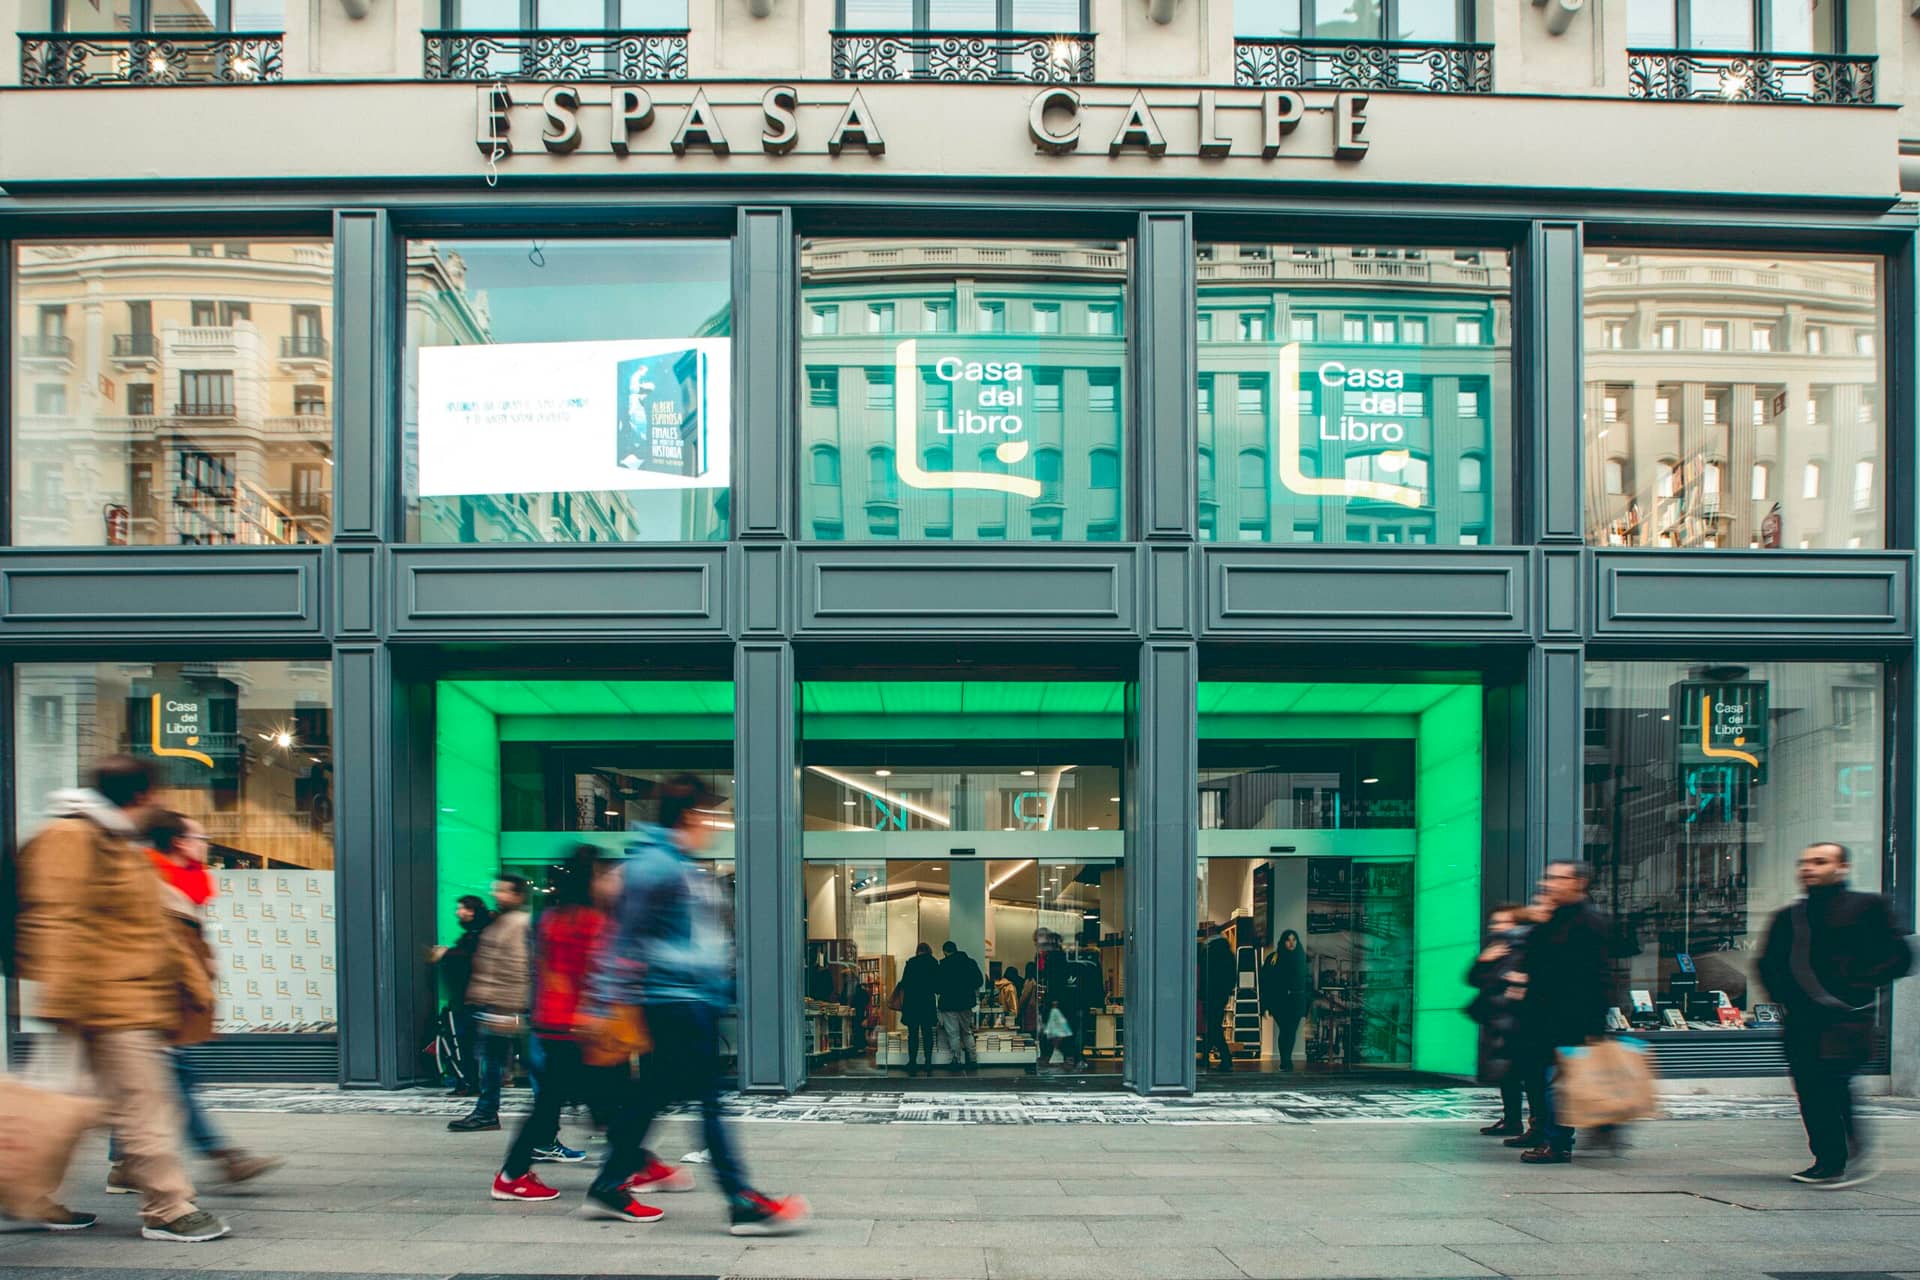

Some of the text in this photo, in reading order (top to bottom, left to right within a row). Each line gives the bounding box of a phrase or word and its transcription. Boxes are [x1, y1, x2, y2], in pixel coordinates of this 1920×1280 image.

[476, 85, 1370, 161] ESPASA CALPE
[935, 356, 1023, 382] Casa
[1318, 361, 1404, 389] Casa
[978, 386, 1023, 407] del
[1360, 389, 1404, 414] del
[937, 409, 1023, 434] Libro
[1320, 416, 1404, 442] Libro
[166, 700, 198, 712] Casa
[1714, 702, 1744, 714] Casa
[166, 723, 198, 734] Libro
[180, 713, 198, 723] del
[1728, 714, 1744, 724] del
[1714, 724, 1744, 735] Libro
